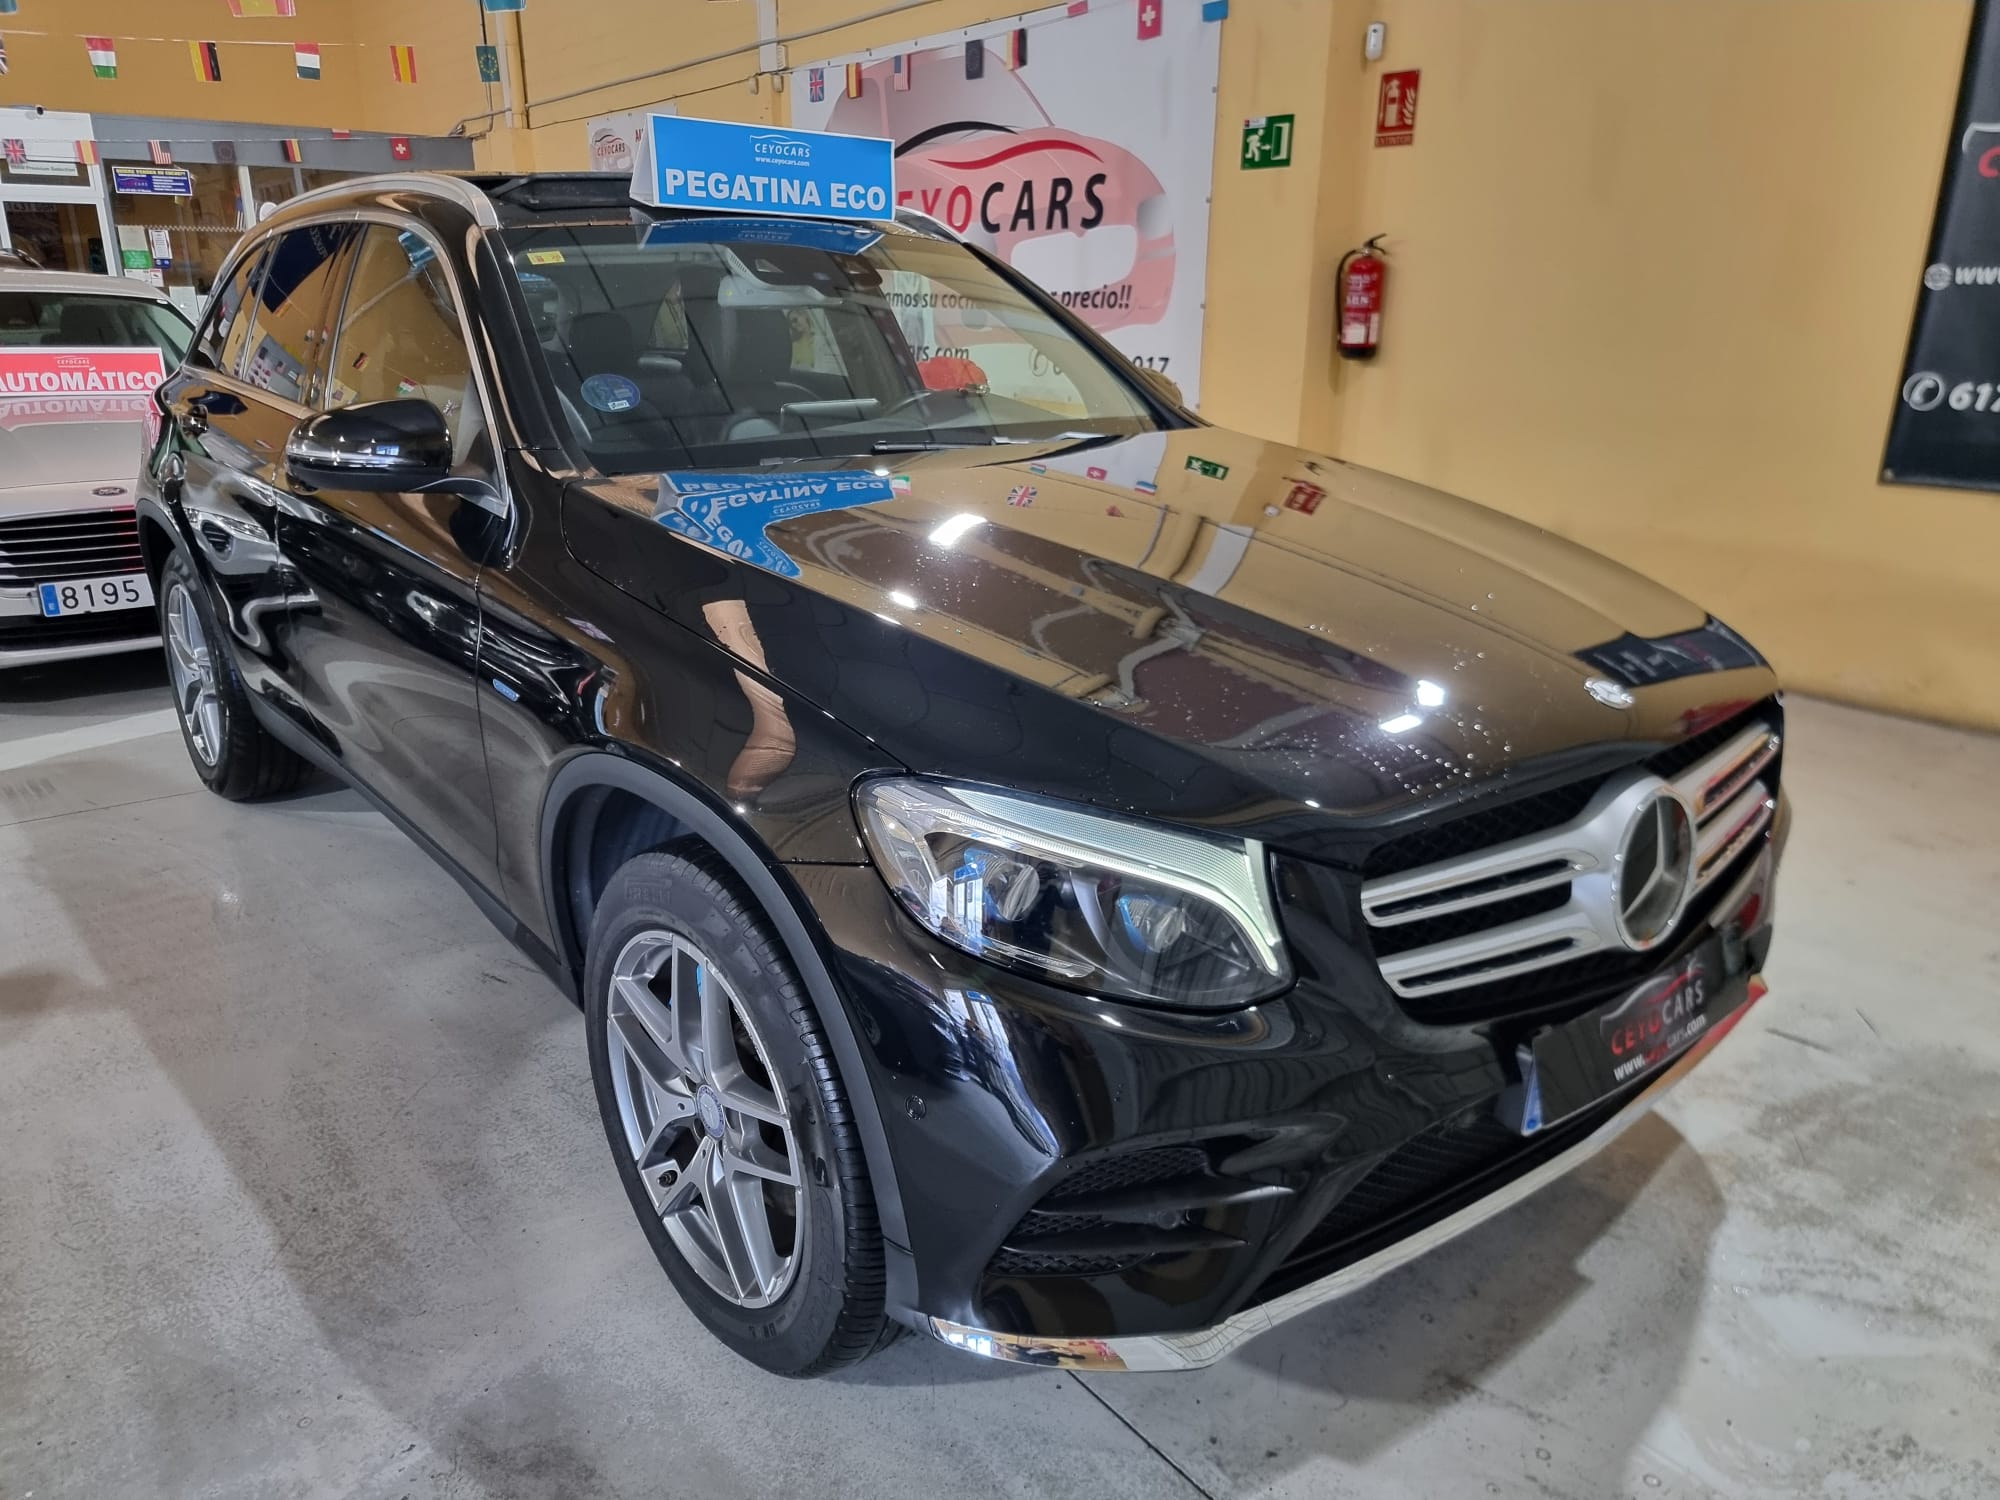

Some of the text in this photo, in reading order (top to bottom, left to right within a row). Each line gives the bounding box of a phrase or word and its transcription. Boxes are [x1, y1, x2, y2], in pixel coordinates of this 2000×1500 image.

[597, 142, 625, 156] CEYOCARS
[752, 143, 810, 157] CEYOCARS
[755, 156, 810, 167] www.ceyocars.com
[665, 168, 886, 211] PEGATINA ECO
[897, 173, 1107, 235] YOCARS
[1060, 284, 1133, 309] precio!!
[61, 580, 139, 609] 8195
[1611, 979, 1704, 1056] CEYOCARS
